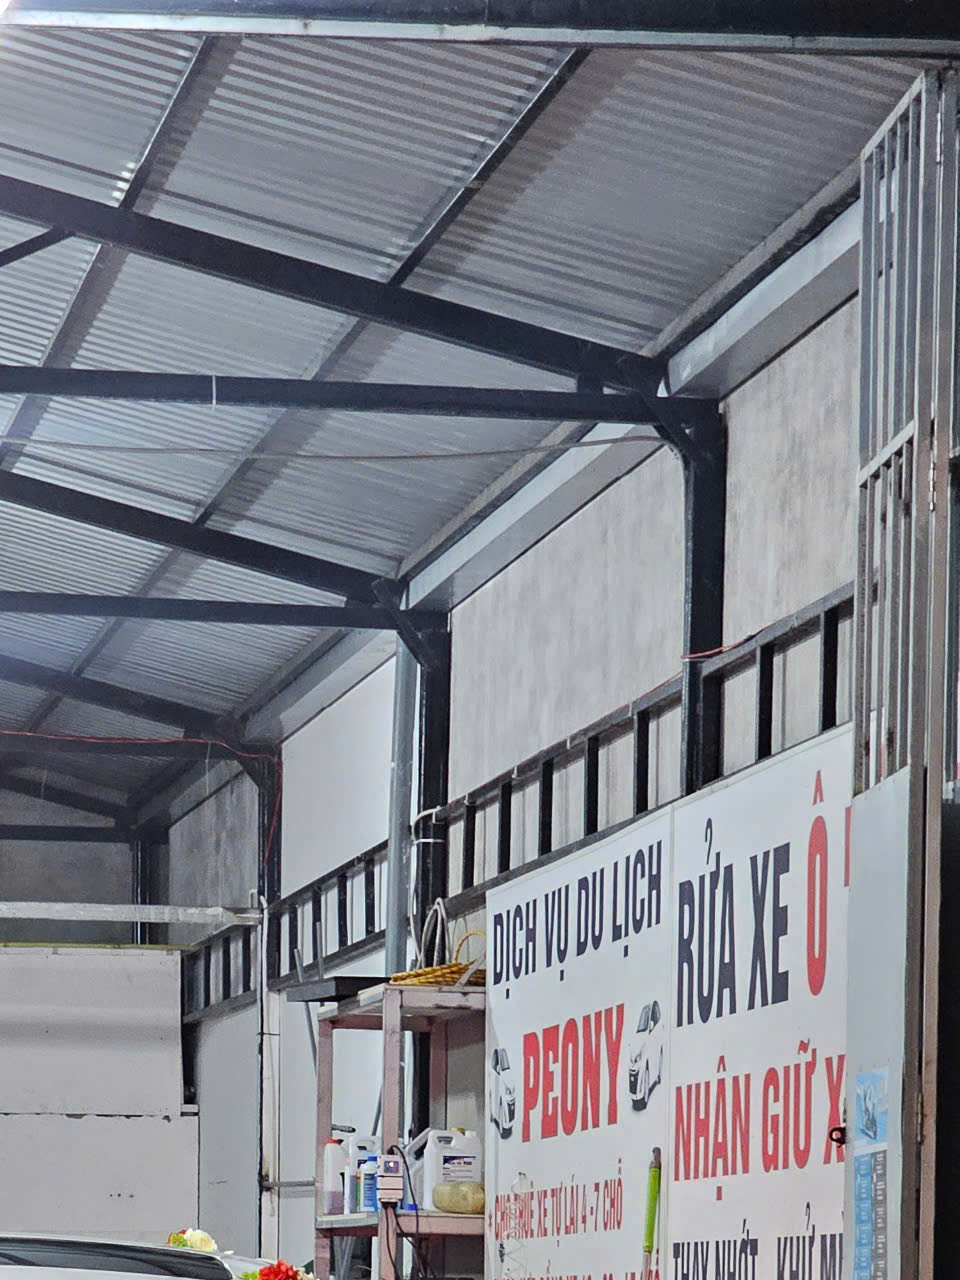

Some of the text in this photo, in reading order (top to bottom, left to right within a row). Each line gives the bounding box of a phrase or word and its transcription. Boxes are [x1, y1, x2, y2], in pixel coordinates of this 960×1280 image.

[493, 840, 662, 999] DỊCH VỤ DU LỊCH
[677, 769, 828, 1027] RỬA XE Ô
[522, 1003, 624, 1143] PEONY
[674, 1056, 752, 1200] NHẬN
[762, 1038, 817, 1174] GIỮ
[536, 1188, 547, 1238] XE
[551, 1181, 564, 1248] TỰ
[564, 1173, 578, 1235] LÁI
[603, 1157, 624, 1231] CHỖ
